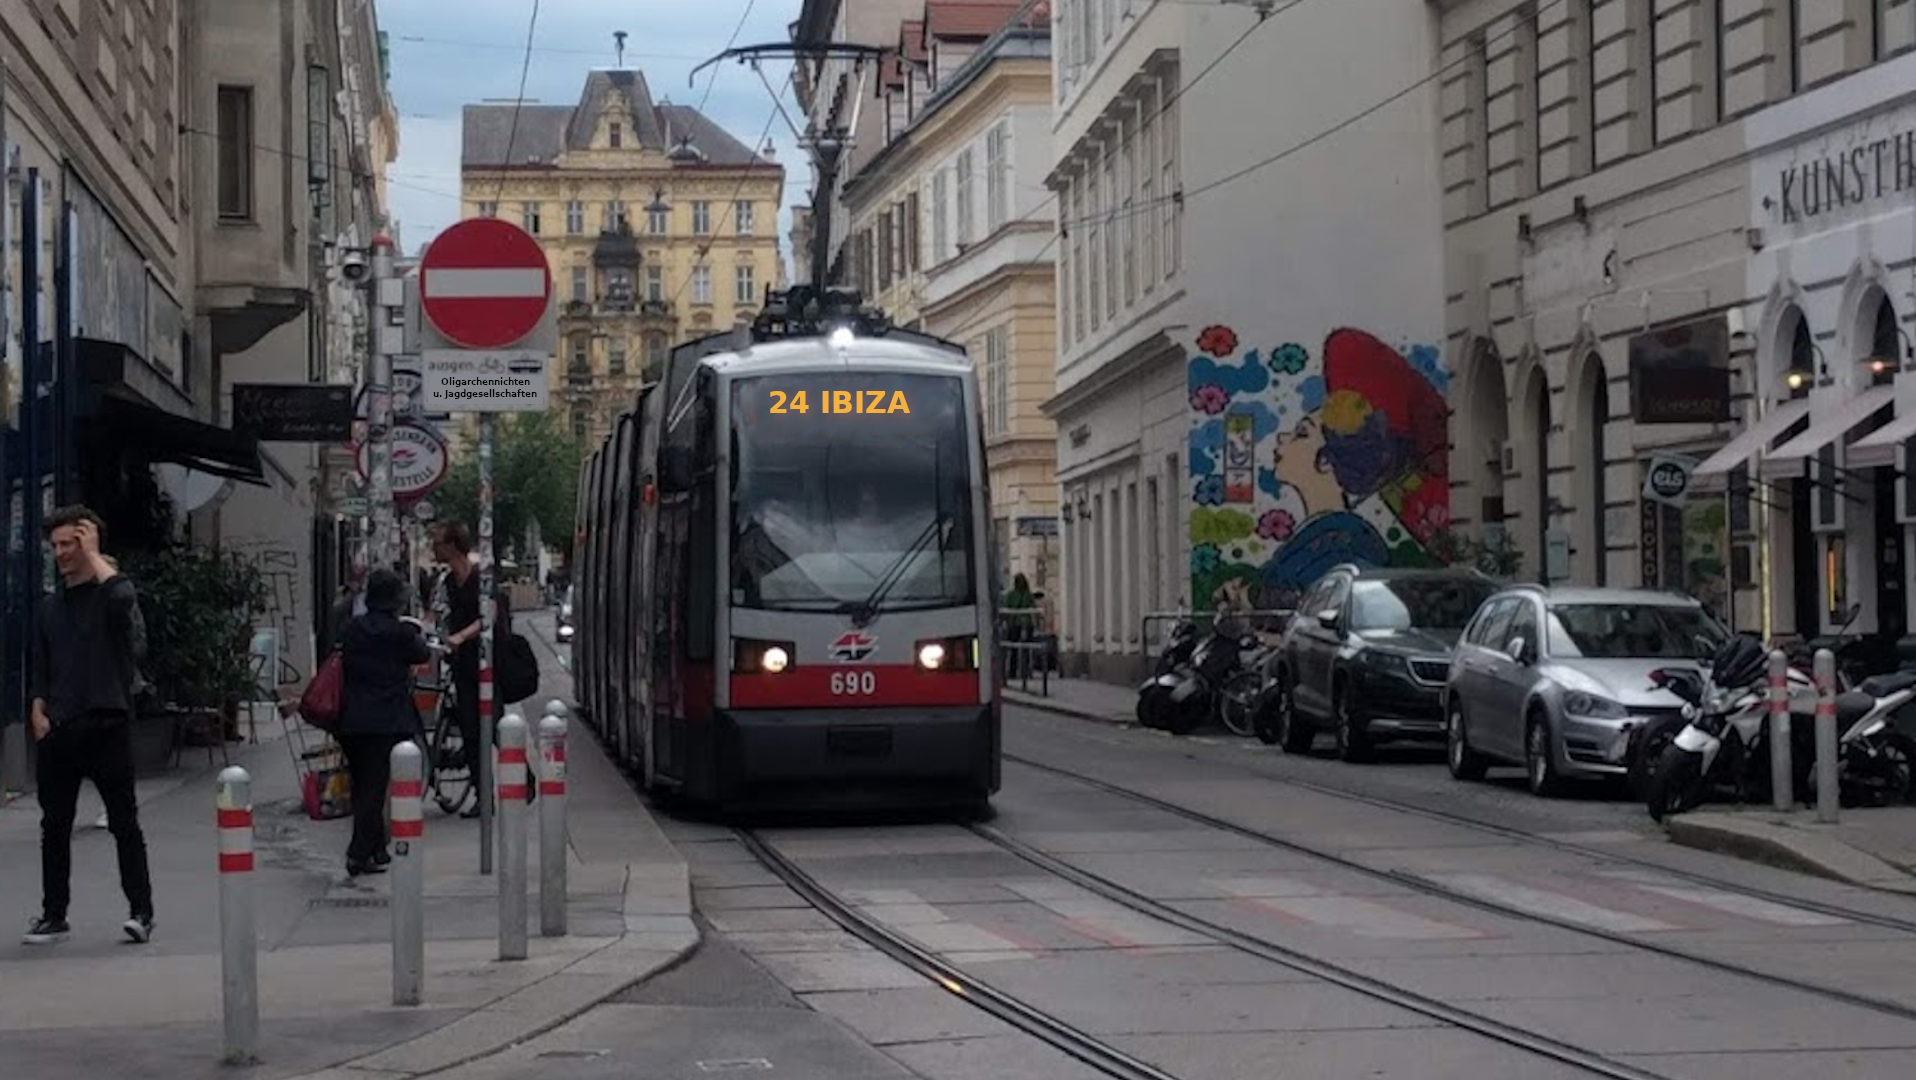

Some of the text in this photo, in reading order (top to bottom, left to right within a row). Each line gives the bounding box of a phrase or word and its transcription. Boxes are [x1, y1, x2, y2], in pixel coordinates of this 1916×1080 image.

[1780, 130, 1916, 224] KUNSTH
[440, 376, 531, 388] Oligarchennichten
[444, 388, 538, 400] Jagdgesellschaften
[769, 391, 910, 414] 24 IBIZA
[392, 467, 435, 486] ESTELLE
[1653, 471, 1684, 486] eis
[830, 672, 875, 693] 690
